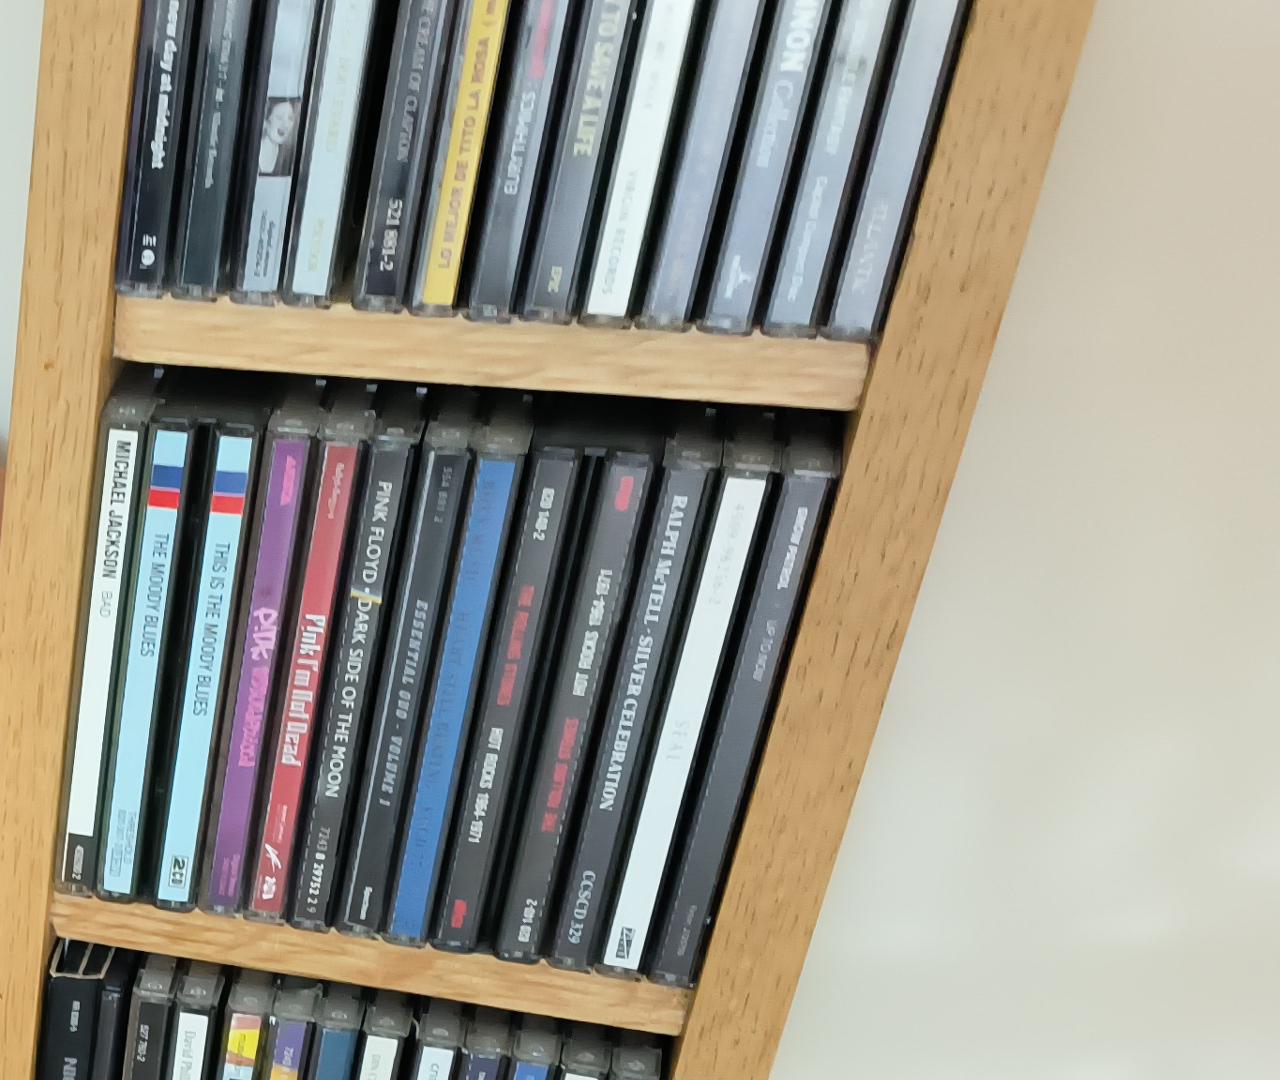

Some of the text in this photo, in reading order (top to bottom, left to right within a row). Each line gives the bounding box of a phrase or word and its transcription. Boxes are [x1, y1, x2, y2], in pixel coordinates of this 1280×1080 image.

[158, 38, 177, 72] day
[469, 35, 490, 84] ROSA
[157, 72, 174, 93] at
[465, 88, 481, 111] LA
[571, 9, 620, 159] TO SAVE A LIFE
[147, 91, 173, 171] midnight
[457, 114, 477, 155] TITO
[452, 159, 468, 182] DE
[383, 197, 403, 227] 521
[436, 247, 452, 269] LO
[96, 439, 134, 618] MICHAEL JACKSON BAD
[773, 544, 800, 592] PATROL
[137, 531, 170, 658] THE MOODY BLUES
[190, 540, 232, 717] THIS IS THE MOODY BLUES
[321, 479, 394, 798] PINK FLOYD DARK SIDE OF THE MOON
[398, 598, 430, 686] ESSENTIAL
[595, 493, 690, 812] RALPH McTELL SILVER CELEBRATION
[278, 720, 309, 767] Dead
[485, 725, 505, 751] HOT
[663, 717, 691, 763] SEAL
[377, 733, 405, 795] VOLUME
[564, 868, 599, 945] CCSCD 329
[180, 1029, 196, 1059] David
